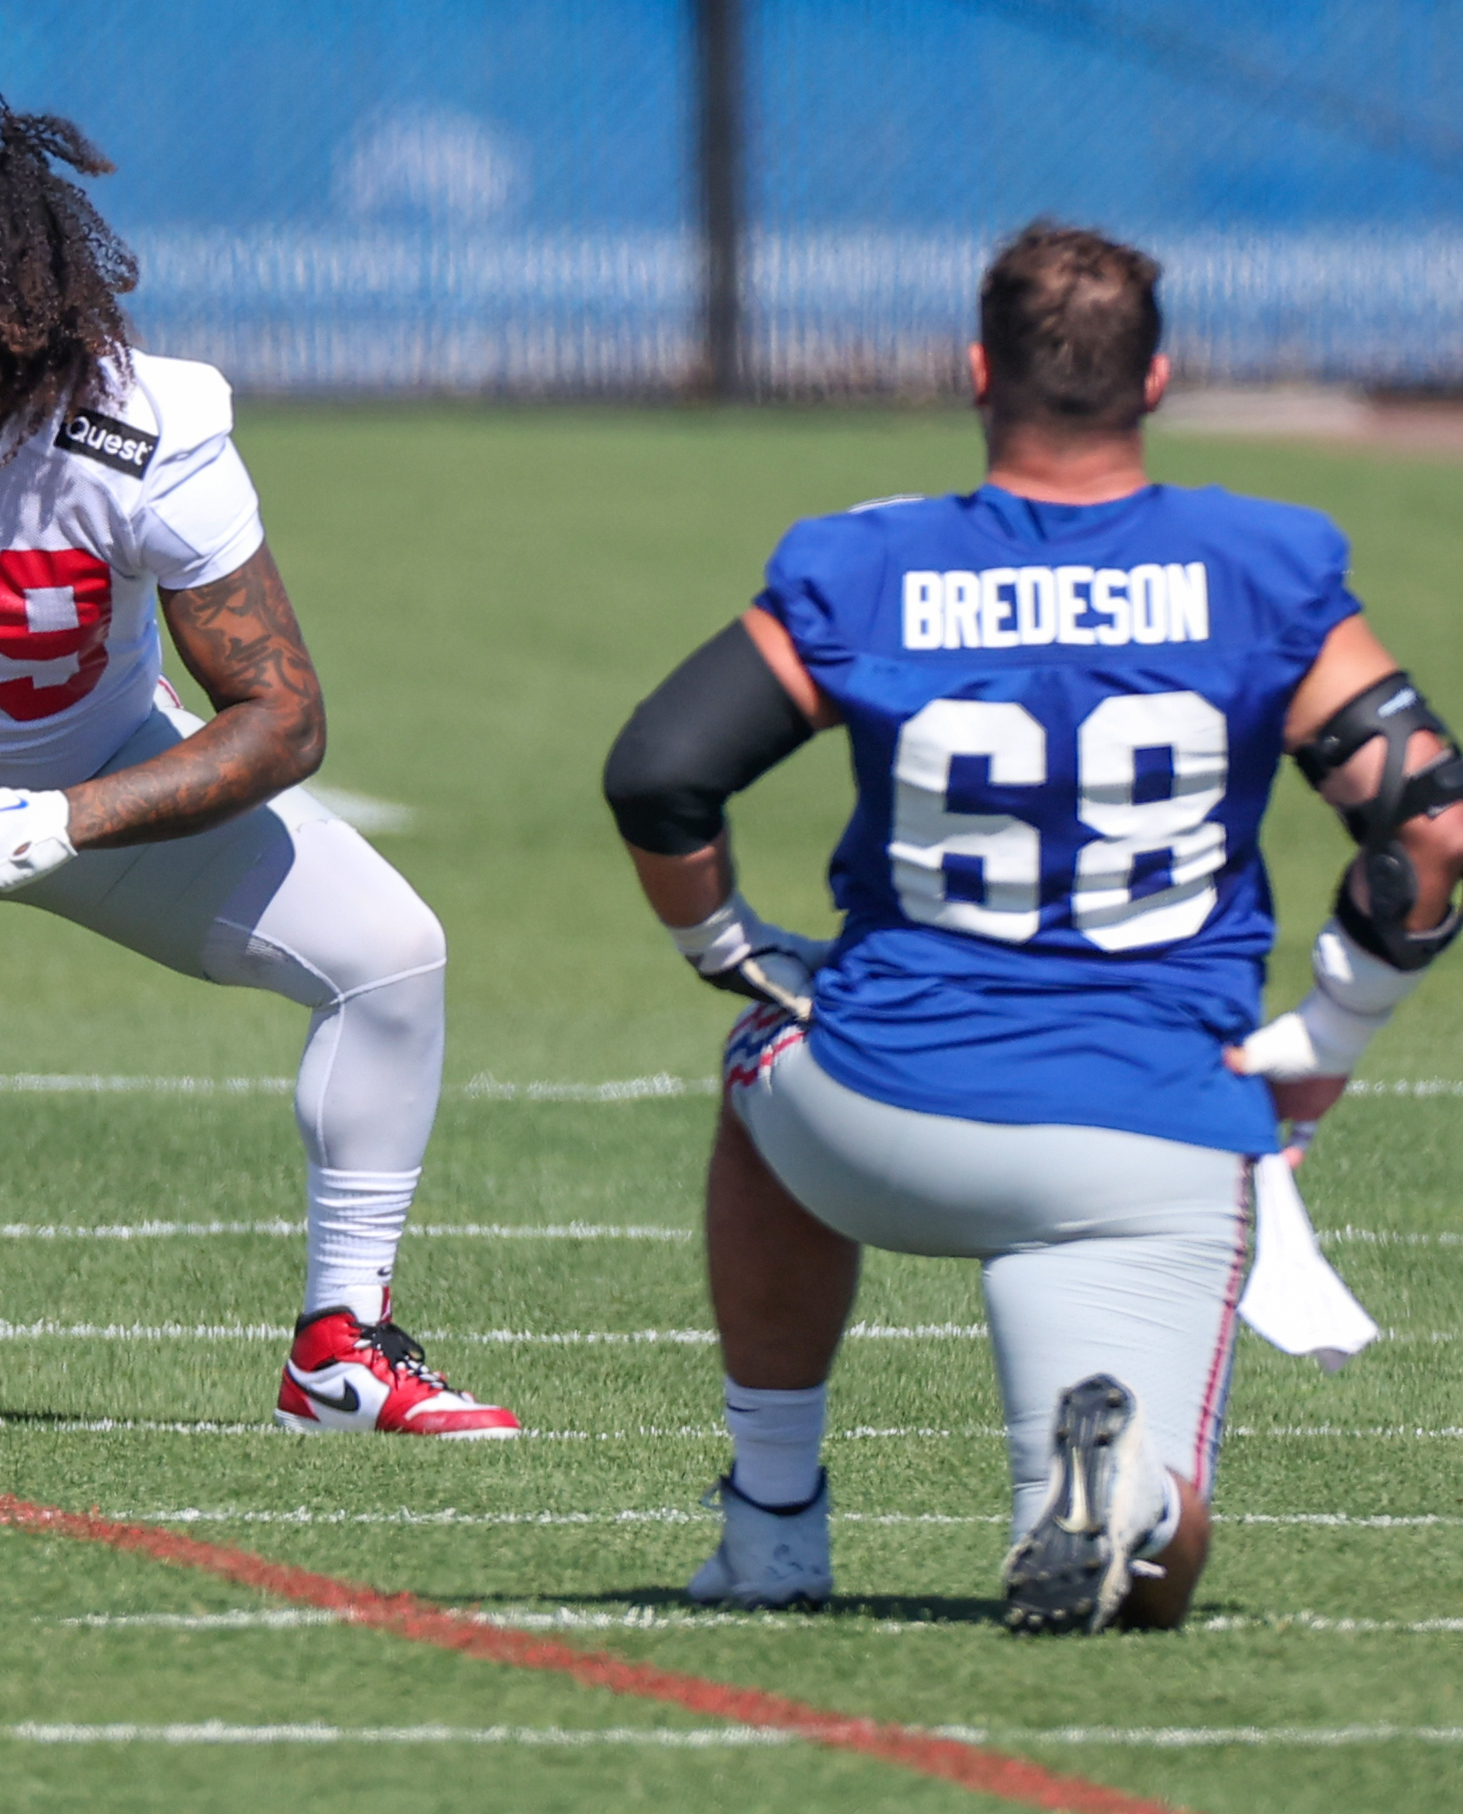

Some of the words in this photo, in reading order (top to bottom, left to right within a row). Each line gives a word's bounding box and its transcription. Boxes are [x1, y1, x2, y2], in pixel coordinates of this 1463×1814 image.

[65, 415, 145, 466] Quest
[902, 562, 1209, 650] BREDESON
[888, 691, 1227, 952] 68
